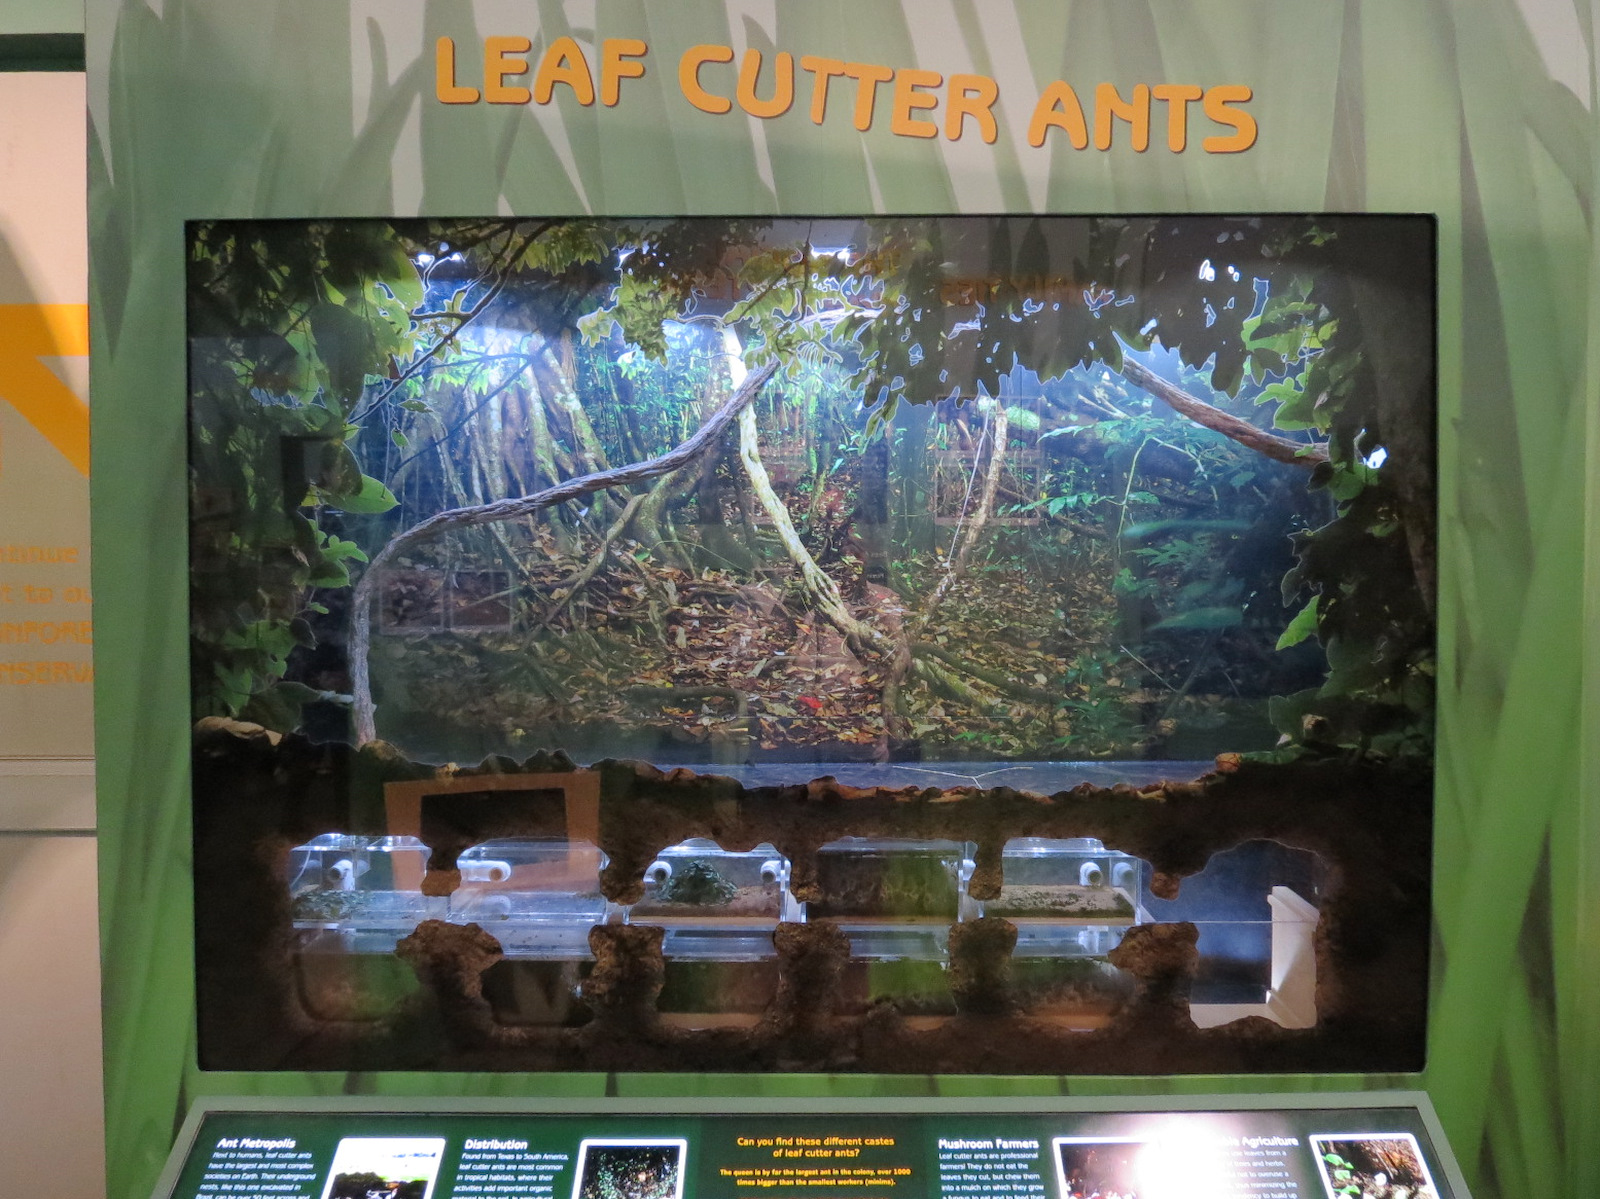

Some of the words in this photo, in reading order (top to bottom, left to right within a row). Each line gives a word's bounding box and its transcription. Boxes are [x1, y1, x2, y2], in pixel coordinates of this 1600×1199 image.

[435, 36, 648, 107] LEAF
[678, 44, 998, 144] CUTTER
[1027, 80, 1259, 154] ANTS
[22, 583, 53, 605] to
[217, 1138, 238, 1149] Ant
[240, 1138, 296, 1150] Metropolis
[464, 1139, 528, 1150] Distribution
[737, 1137, 755, 1146] Can
[756, 1137, 773, 1148] you
[775, 1137, 793, 1146] find
[795, 1137, 821, 1146] these
[823, 1137, 863, 1146] different
[864, 1137, 895, 1146] castes
[938, 1139, 993, 1149] Mushroom
[995, 1139, 1039, 1149] Farmers
[1241, 1136, 1299, 1148] Agriculture
[773, 1149, 783, 1157] of
[785, 1149, 803, 1157] leaf
[804, 1149, 832, 1157] cutter
[834, 1149, 860, 1157] ants?
[1000, 1152, 1039, 1160] professional
[966, 1163, 982, 1171] They
[733, 1169, 753, 1177] queen
[762, 1169, 770, 1177] by
[795, 1169, 818, 1177] largest
[757, 1179, 778, 1187] bigger
